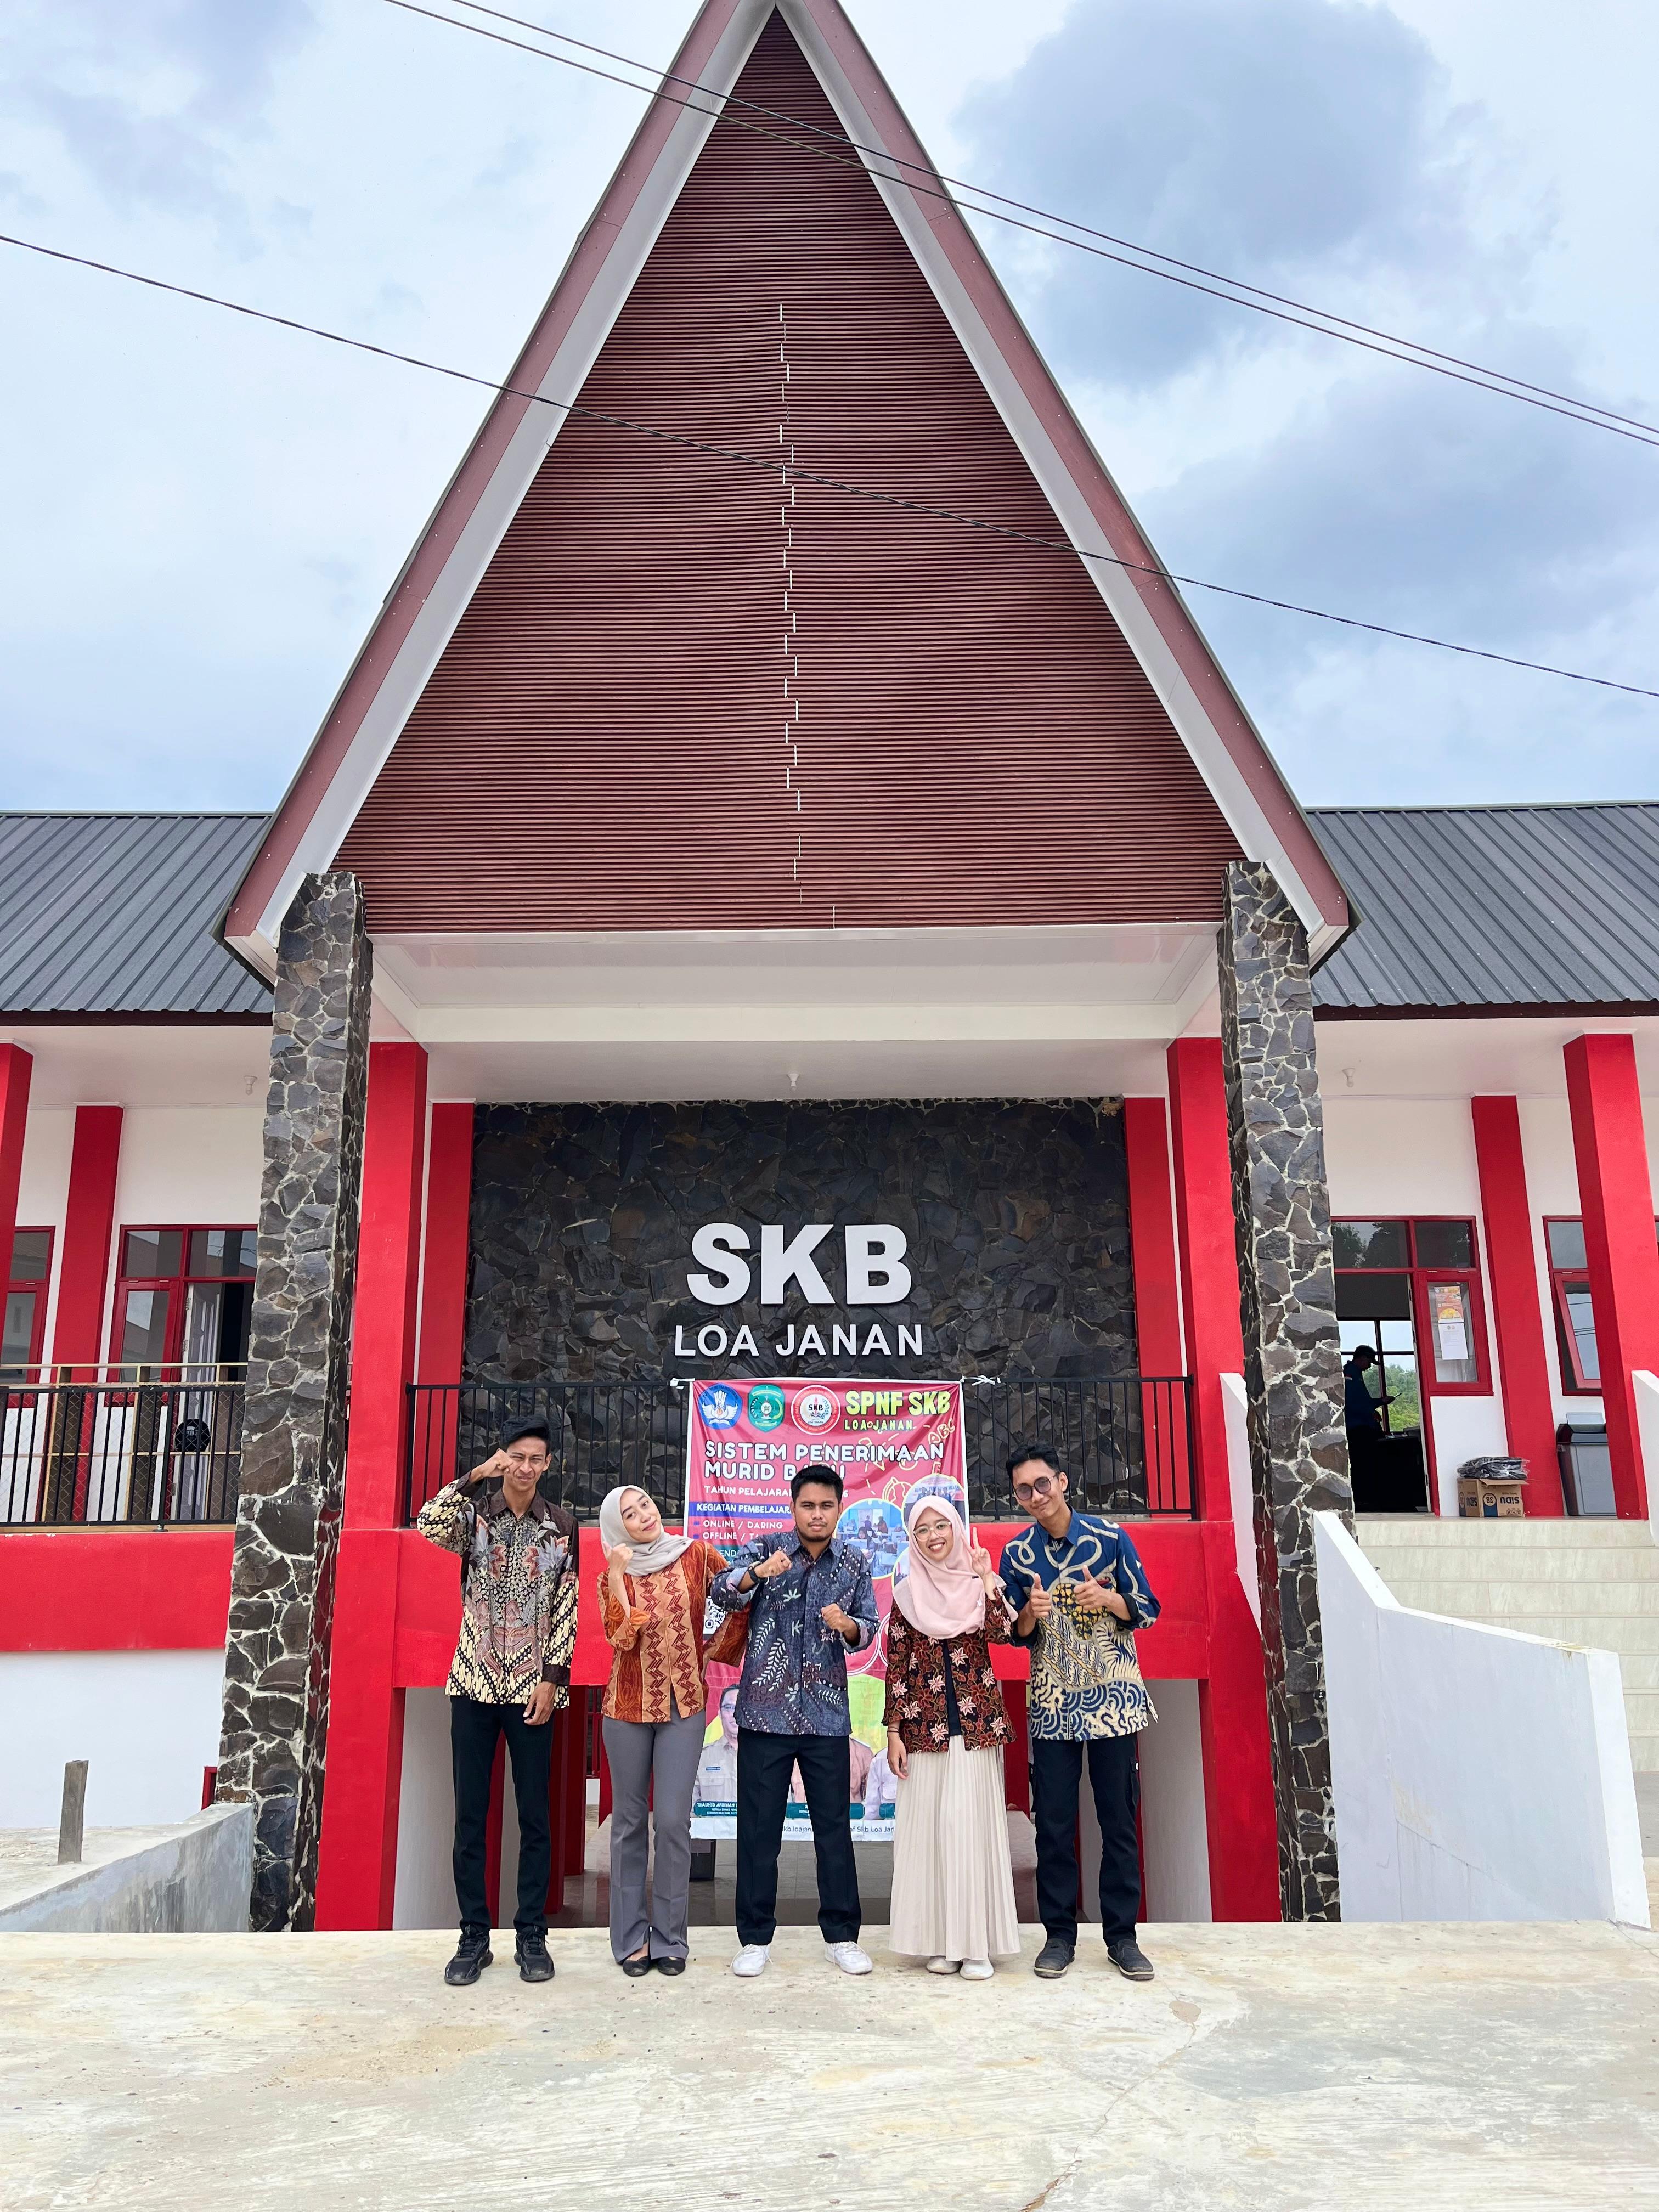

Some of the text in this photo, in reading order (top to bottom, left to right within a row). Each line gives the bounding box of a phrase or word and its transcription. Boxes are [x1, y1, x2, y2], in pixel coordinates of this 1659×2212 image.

[686, 1222, 912, 1305] SKB
[674, 1323, 923, 1357] LOA JANAN
[845, 1390, 903, 1415] SPNF
[908, 1391, 951, 1416] SKB
[844, 1419, 868, 1430] LOA
[873, 1419, 913, 1430] JANAN
[705, 1440, 944, 1462] SISTEM PENERIMAAN
[704, 1460, 775, 1481] MURID
[703, 1485, 736, 1494] TAHUN
[697, 1503, 792, 1514] KEGIATAN PEMBELAJAR
[703, 1520, 783, 1530] ONLINE / DARING
[702, 1532, 737, 1540] OFFLINE
[740, 1533, 746, 1542] /
